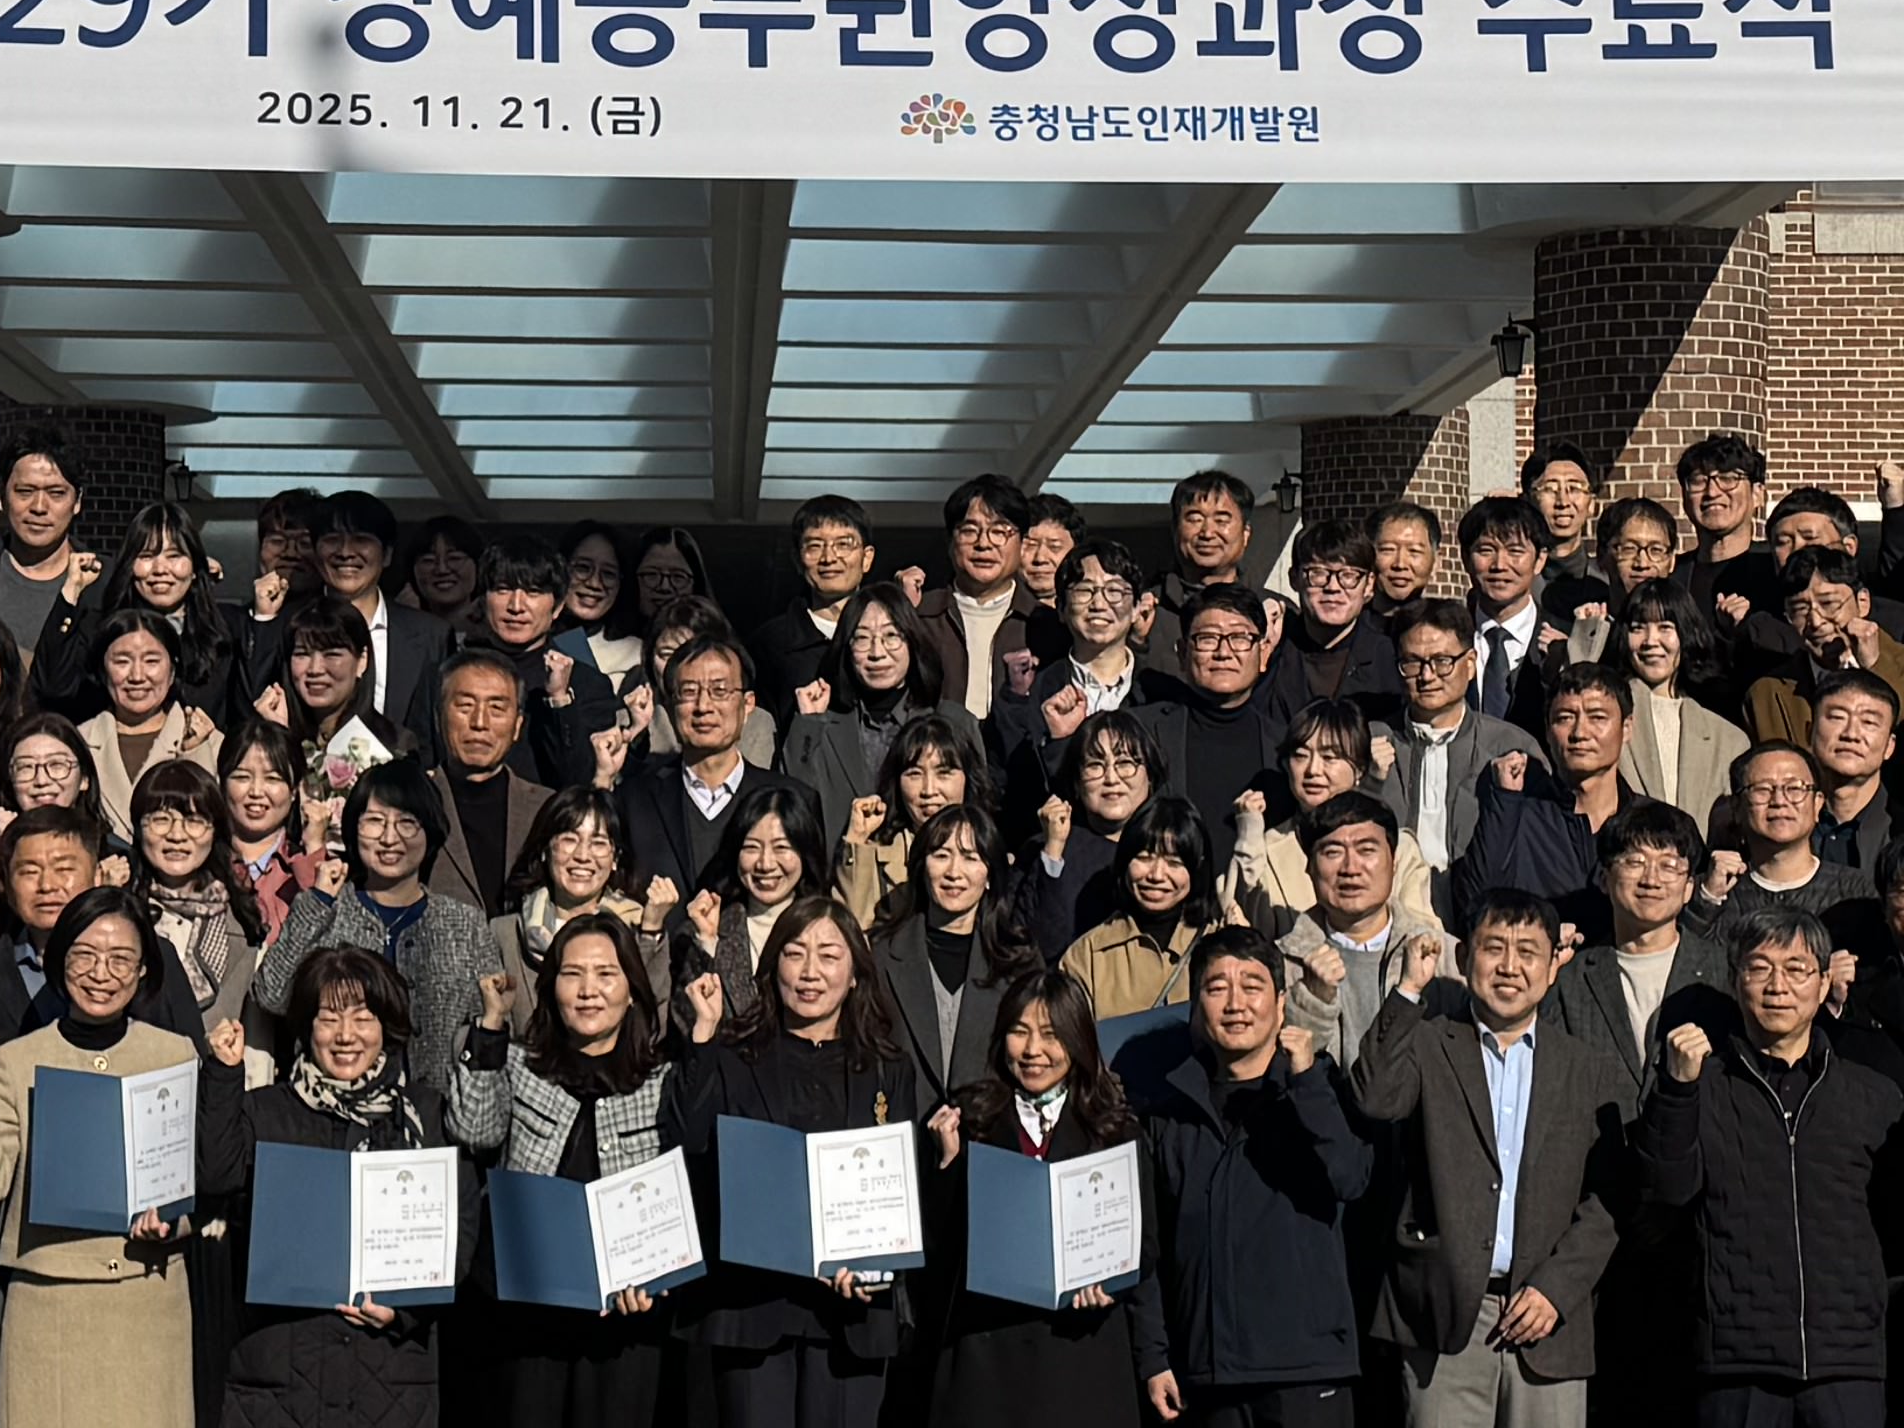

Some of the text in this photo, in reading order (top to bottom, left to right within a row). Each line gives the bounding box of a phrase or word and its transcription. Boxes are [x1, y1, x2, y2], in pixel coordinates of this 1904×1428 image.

[257, 91, 662, 137] 2025. 11. 21. (금)
[988, 103, 1321, 144] 충청남도인재개발원
